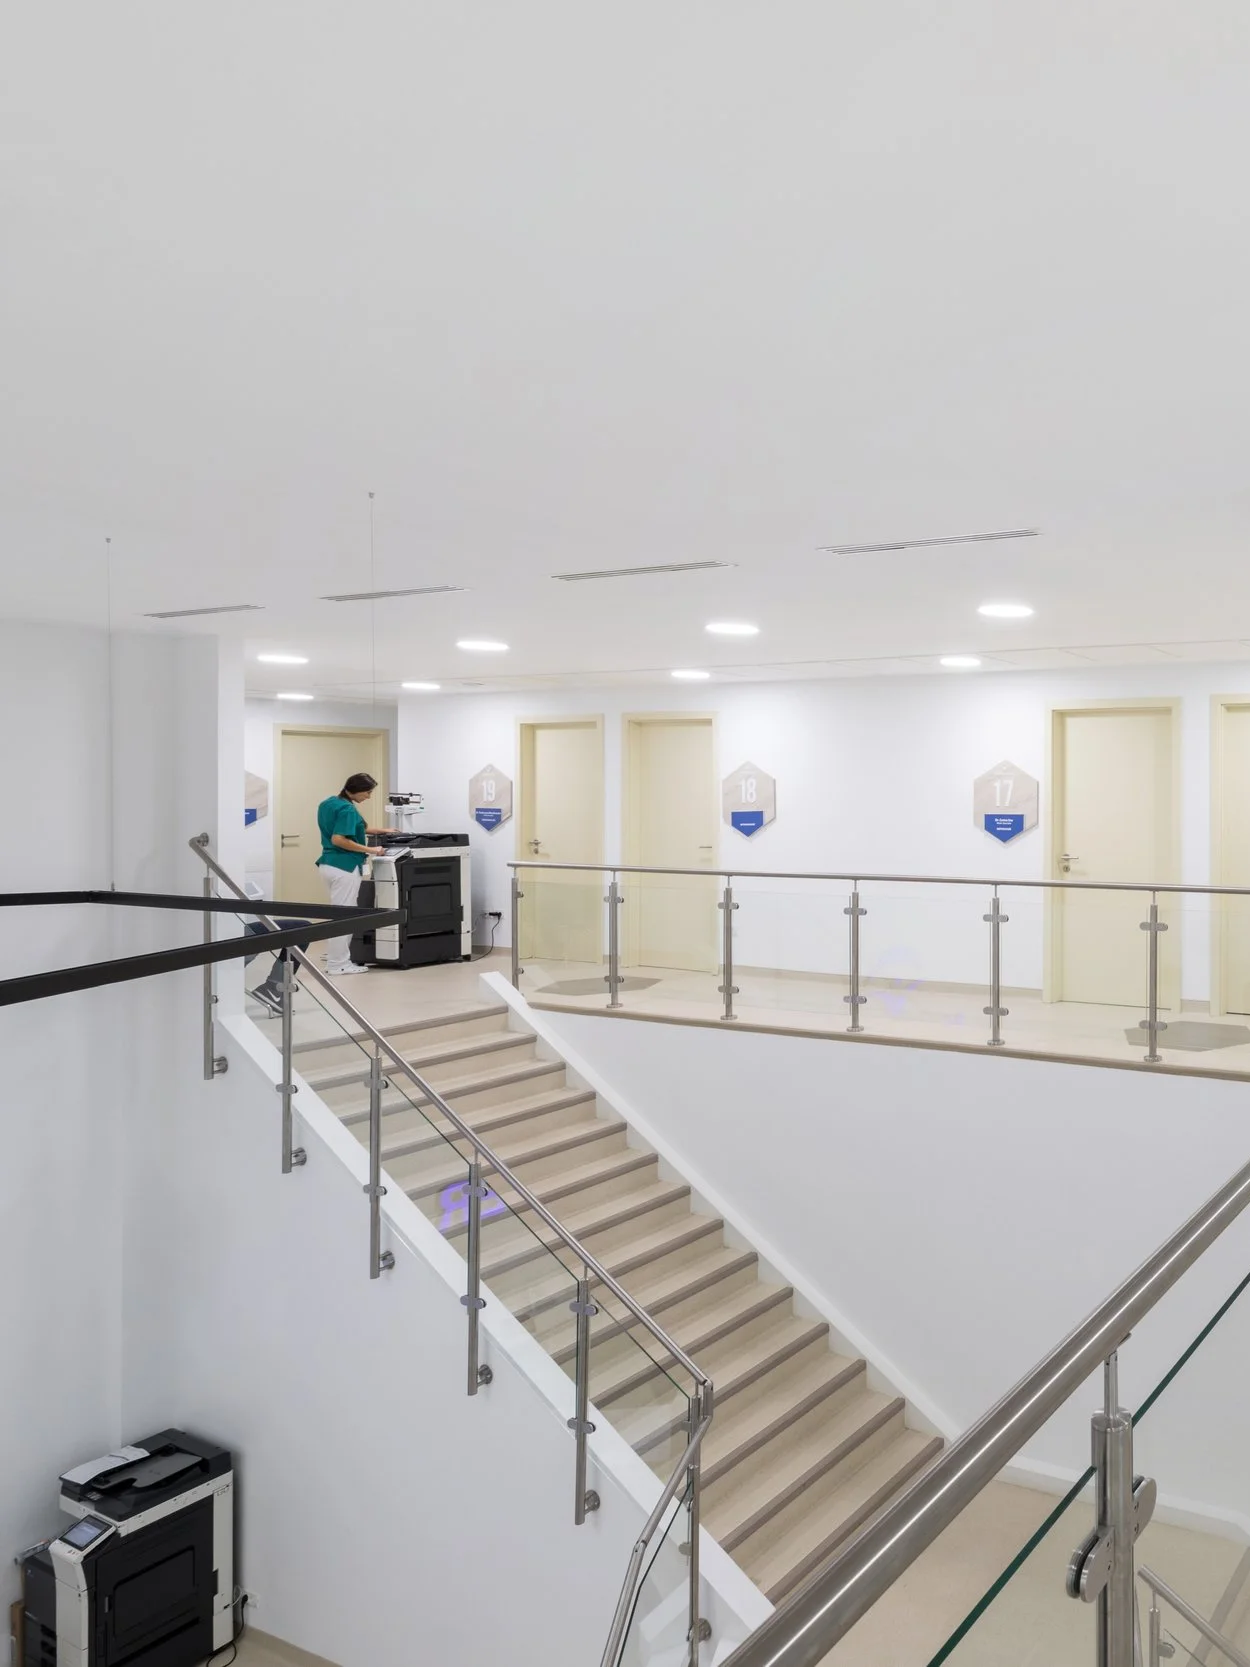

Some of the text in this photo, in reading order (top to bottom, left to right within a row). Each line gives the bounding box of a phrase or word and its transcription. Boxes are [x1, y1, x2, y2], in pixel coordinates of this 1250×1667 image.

[481, 780, 496, 803] 19
[740, 776, 757, 804] 18
[994, 779, 1014, 807] 17
